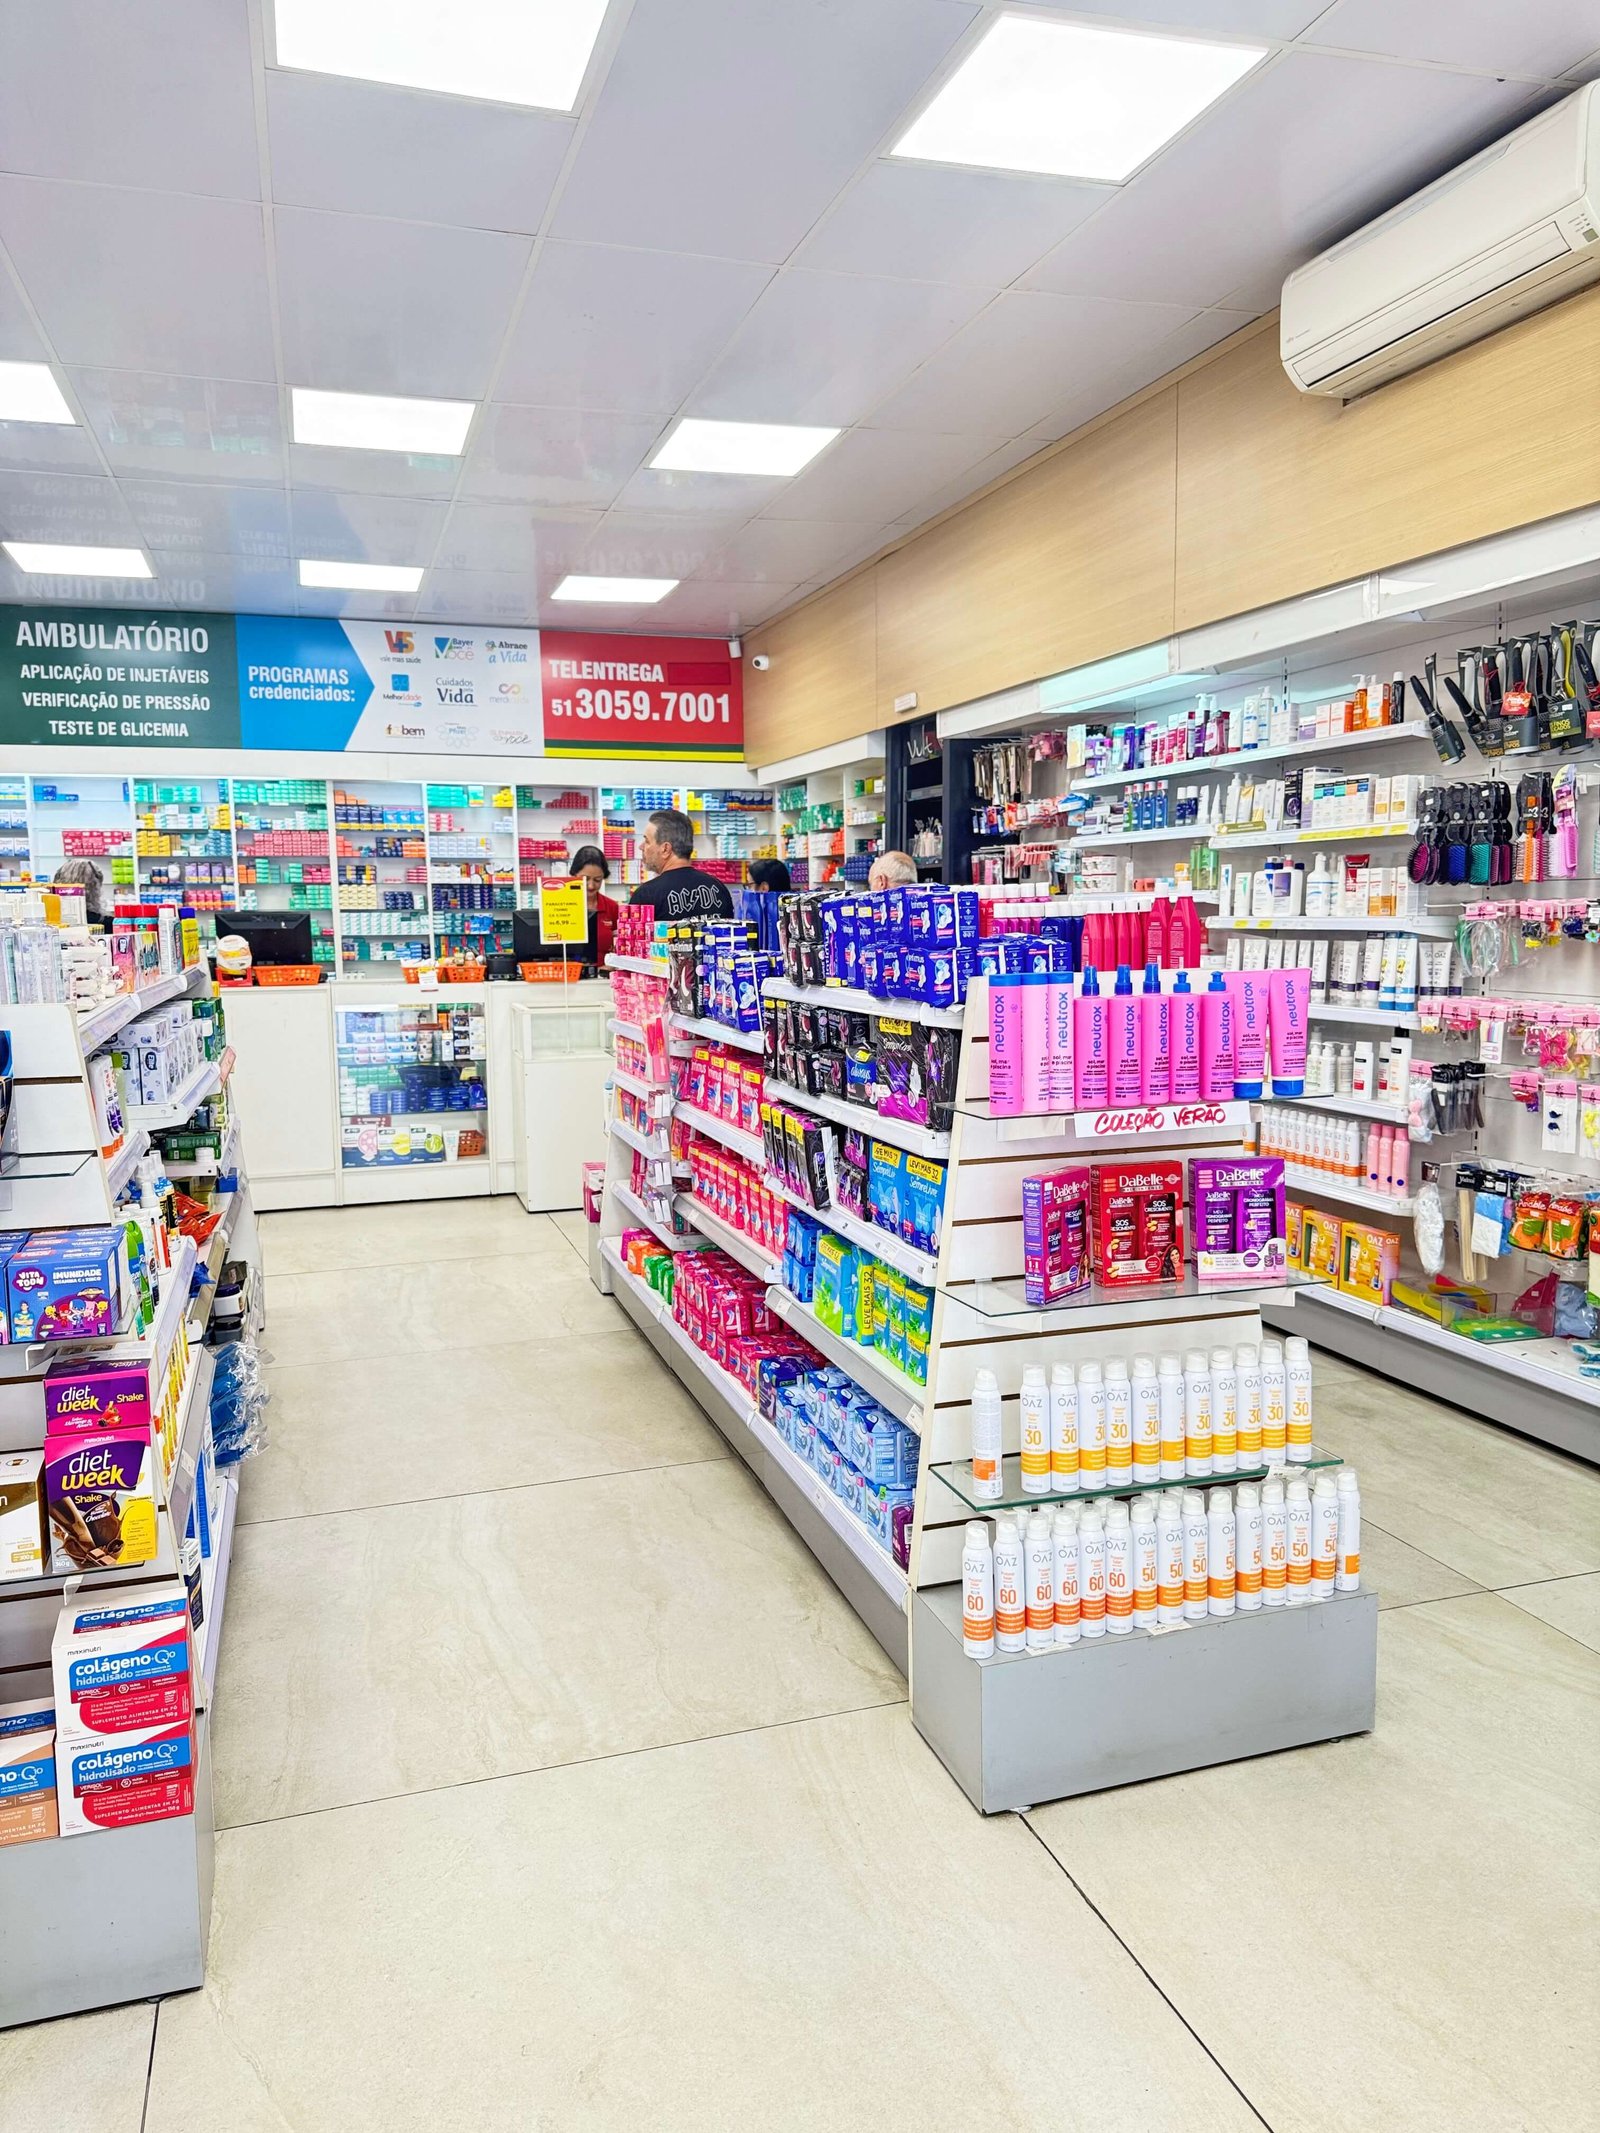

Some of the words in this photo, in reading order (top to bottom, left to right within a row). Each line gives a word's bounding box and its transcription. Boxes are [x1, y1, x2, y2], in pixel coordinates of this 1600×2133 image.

[16, 620, 209, 653] AMBULATÓRIO
[498, 641, 527, 650] Abrace
[489, 655, 496, 663] a
[500, 650, 527, 663] Vida
[20, 663, 102, 684] APLICAÇÃO
[107, 667, 126, 681] DE
[130, 666, 209, 684] INJETÁVEIS
[249, 665, 349, 685] PROGRAMAS
[548, 659, 664, 683] TELENTREGA
[435, 677, 473, 687] Cuidados
[249, 685, 355, 702] credenciados:
[437, 688, 474, 703] Vida
[22, 691, 118, 712] VERIFICAÇÃO
[123, 695, 142, 709] DE
[146, 694, 210, 711] PRESSÃO
[551, 700, 572, 717] 51
[576, 688, 730, 723] 3059.7001
[49, 720, 94, 735] TESTE
[98, 721, 117, 735] DE
[121, 722, 189, 737] GLICEMIA
[1244, 981, 1255, 1029] neutrox
[1285, 980, 1298, 1027] neutrox
[993, 995, 1004, 1053] neutrox
[1057, 992, 1068, 1049] neutrox
[1184, 1002, 1194, 1053] neutrox
[1220, 1001, 1230, 1051] neutrox
[1091, 1006, 1102, 1057] neutrox
[1124, 1005, 1135, 1056] neutrox
[1159, 1003, 1168, 1054] neutrox
[851, 1064, 871, 1083] always
[1094, 1106, 1165, 1134] COLEÇÃO
[1173, 1103, 1226, 1128] VERÃO
[1119, 1173, 1163, 1187] DaBelle
[1216, 1168, 1264, 1182] DaBelle
[1053, 1182, 1080, 1199] DaBelle
[1115, 1219, 1128, 1227] SOS
[1323, 1221, 1338, 1232] OAZ
[1367, 1234, 1383, 1245] OAZ
[19, 1271, 40, 1279] VITA
[53, 1269, 102, 1279] IMUNIDADE
[863, 1271, 873, 1284] 32
[16, 1277, 44, 1287] TOON
[1263, 1375, 1284, 1384] OAZ
[1289, 1372, 1309, 1380] OAZ
[61, 1385, 92, 1401] diet
[1107, 1392, 1128, 1401] OAZ
[57, 1395, 103, 1412] week
[116, 1392, 144, 1403] Shake
[1022, 1397, 1042, 1407] OAZ
[1058, 1397, 1077, 1407] OAZ
[1293, 1402, 1309, 1416] 30
[1267, 1406, 1283, 1420] 30
[1145, 1420, 1158, 1435] 30
[1197, 1414, 1210, 1429] 30
[1025, 1429, 1041, 1445] 30
[1062, 1428, 1077, 1443] 30
[1111, 1424, 1127, 1438] 30
[68, 1449, 112, 1472] diet
[61, 1465, 127, 1491] week
[74, 1493, 102, 1504] Shake
[1289, 1512, 1309, 1521] OAZ
[1106, 1540, 1127, 1551] OAZ
[1292, 1543, 1308, 1557] 50
[996, 1555, 1018, 1566] OAZ
[1271, 1546, 1285, 1561] 50
[964, 1562, 985, 1573] OAZ
[1170, 1562, 1183, 1578] 50
[1193, 1559, 1206, 1573] 50
[1109, 1572, 1125, 1588] 60
[1142, 1567, 1156, 1581] 50
[1063, 1580, 1077, 1595] 60
[1089, 1575, 1104, 1591] 60
[1000, 1589, 1016, 1604] 60
[1037, 1584, 1051, 1600] 60
[967, 1595, 983, 1611] 60
[82, 1606, 154, 1621] colágeno
[67, 1646, 101, 1656] maxinutri
[76, 1655, 151, 1675] colágeno
[76, 1671, 133, 1686] hidrolisado
[92, 1714, 127, 1725] SUPLEMENTO
[128, 1709, 159, 1719] ALIMENTAR
[70, 1741, 104, 1751] maxinutri
[79, 1749, 154, 1770] colágeno
[79, 1765, 136, 1782] hidrolisado
[94, 1809, 129, 1820] SUPLEMENTO
[131, 1803, 161, 1812] ALIMENTAR
